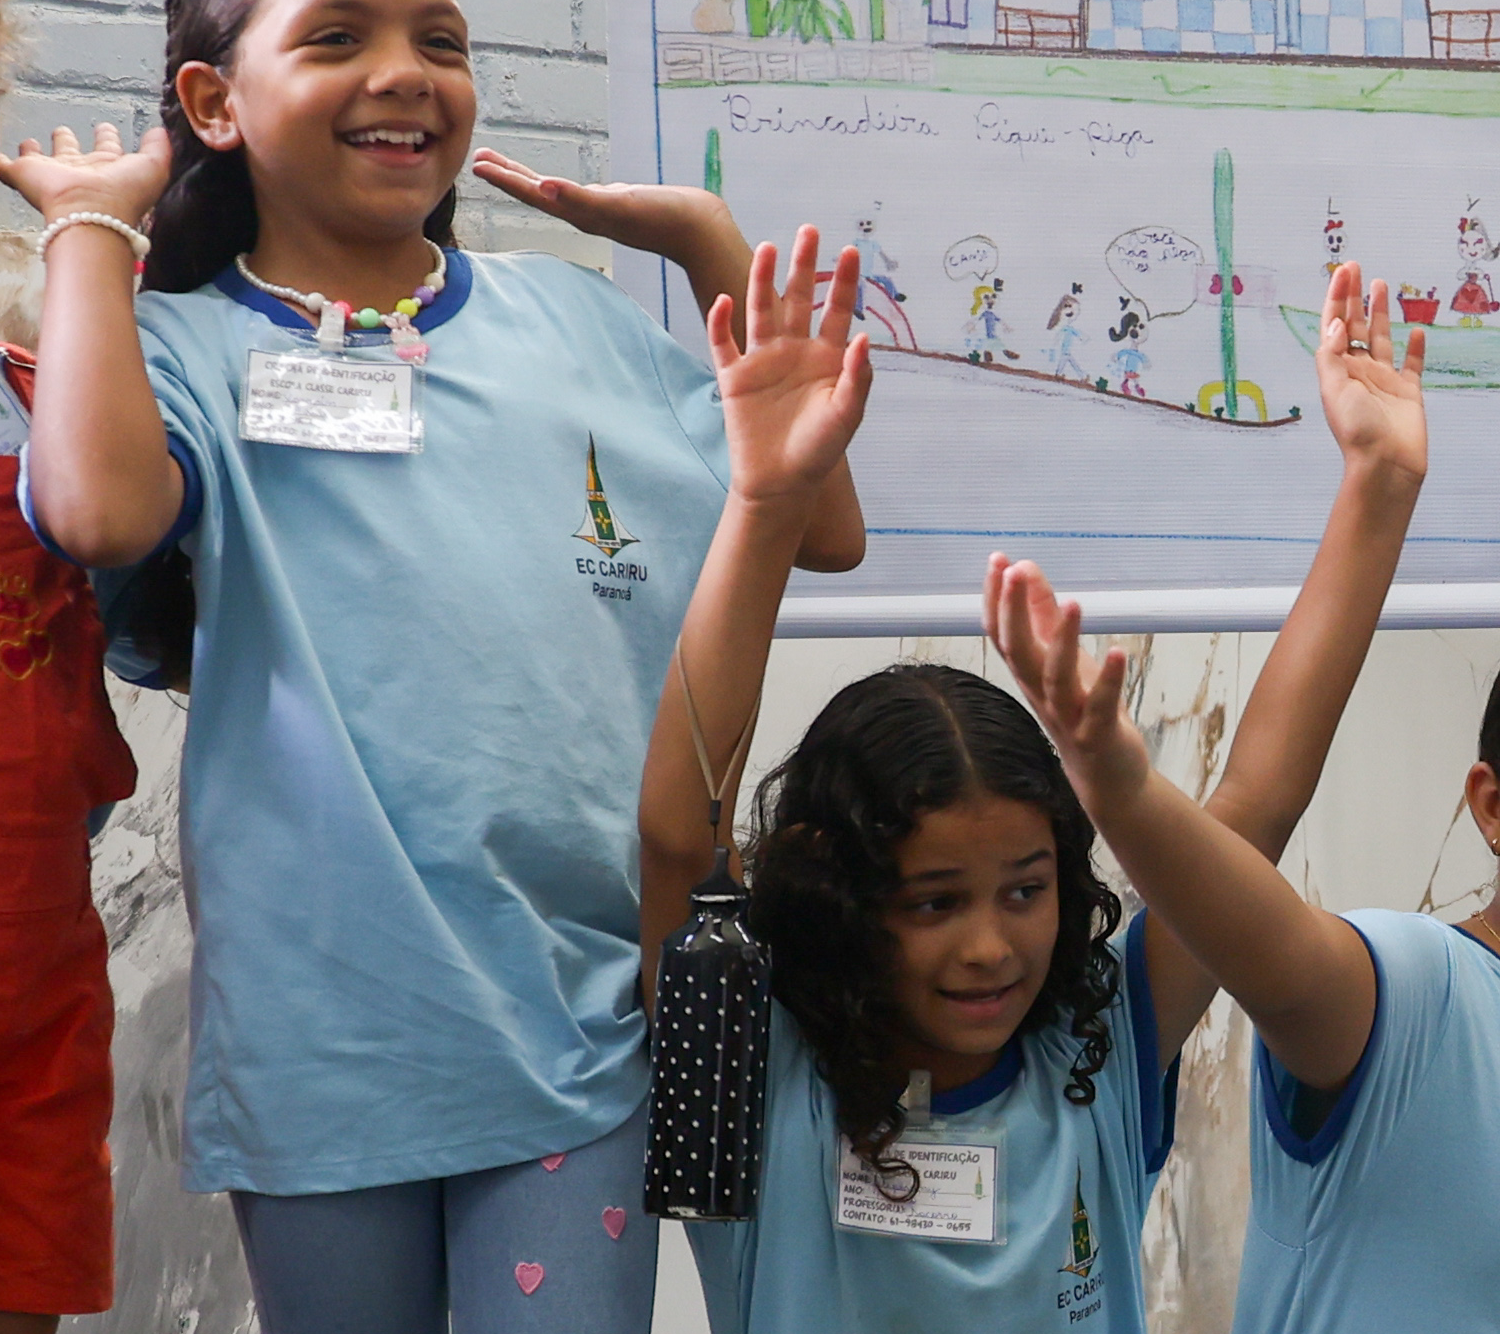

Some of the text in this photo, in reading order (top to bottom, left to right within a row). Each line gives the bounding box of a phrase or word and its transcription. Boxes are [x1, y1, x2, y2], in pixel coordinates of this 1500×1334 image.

[1327, 196, 1340, 215] L
[575, 558, 648, 582] EC CARIRU
[592, 582, 632, 601] Paranoá
[908, 1150, 980, 1164] IDENTIFICAÇÃO
[923, 1170, 957, 1180] CARIRU
[1057, 1289, 1071, 1310] EC
